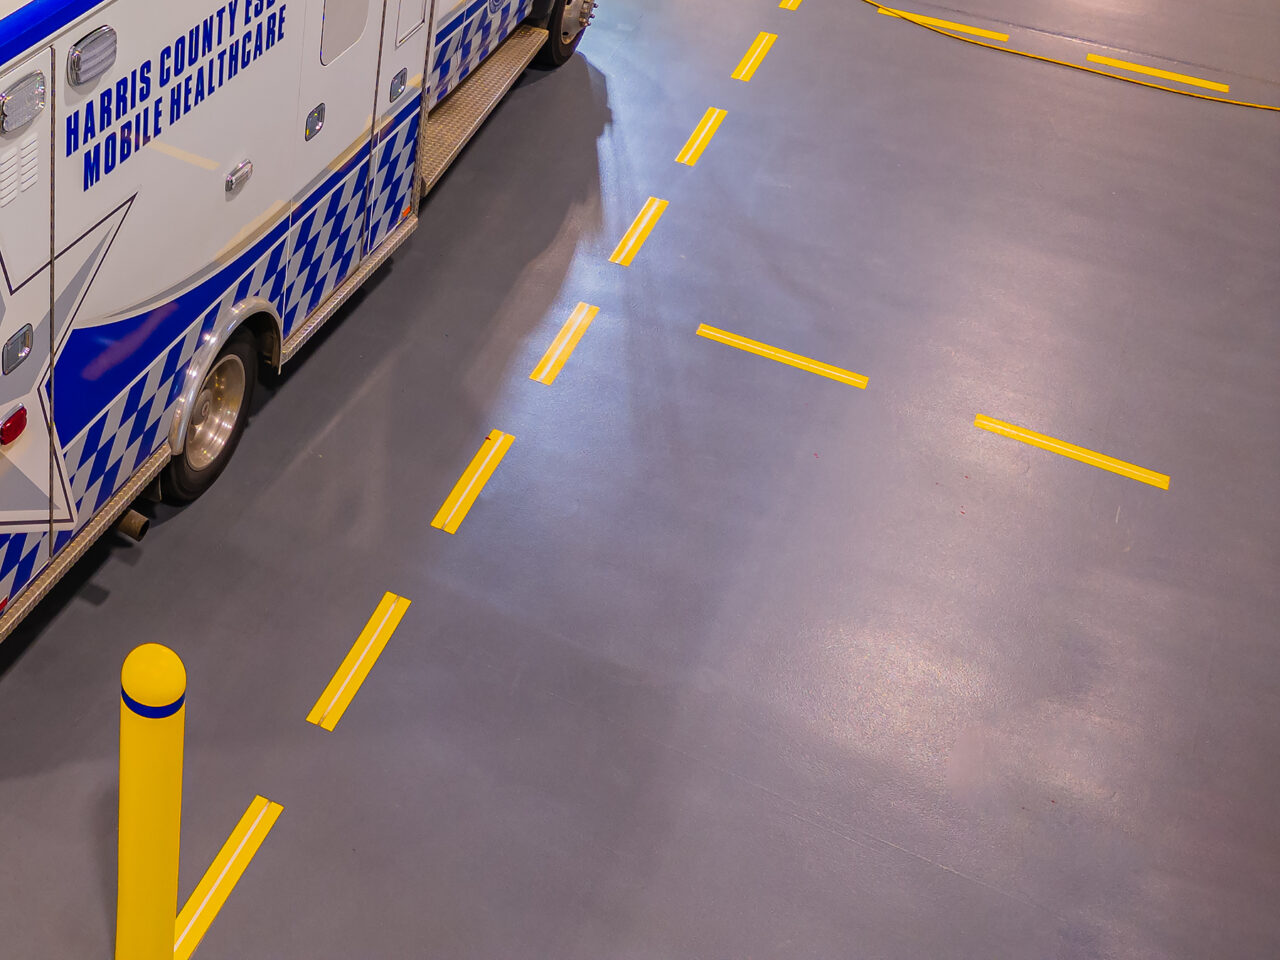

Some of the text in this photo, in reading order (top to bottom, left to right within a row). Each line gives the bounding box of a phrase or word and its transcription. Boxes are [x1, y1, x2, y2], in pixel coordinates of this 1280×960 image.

[66, 59, 152, 158] HARRIS
[83, 4, 287, 193] MOBILE HEALTHCARE
